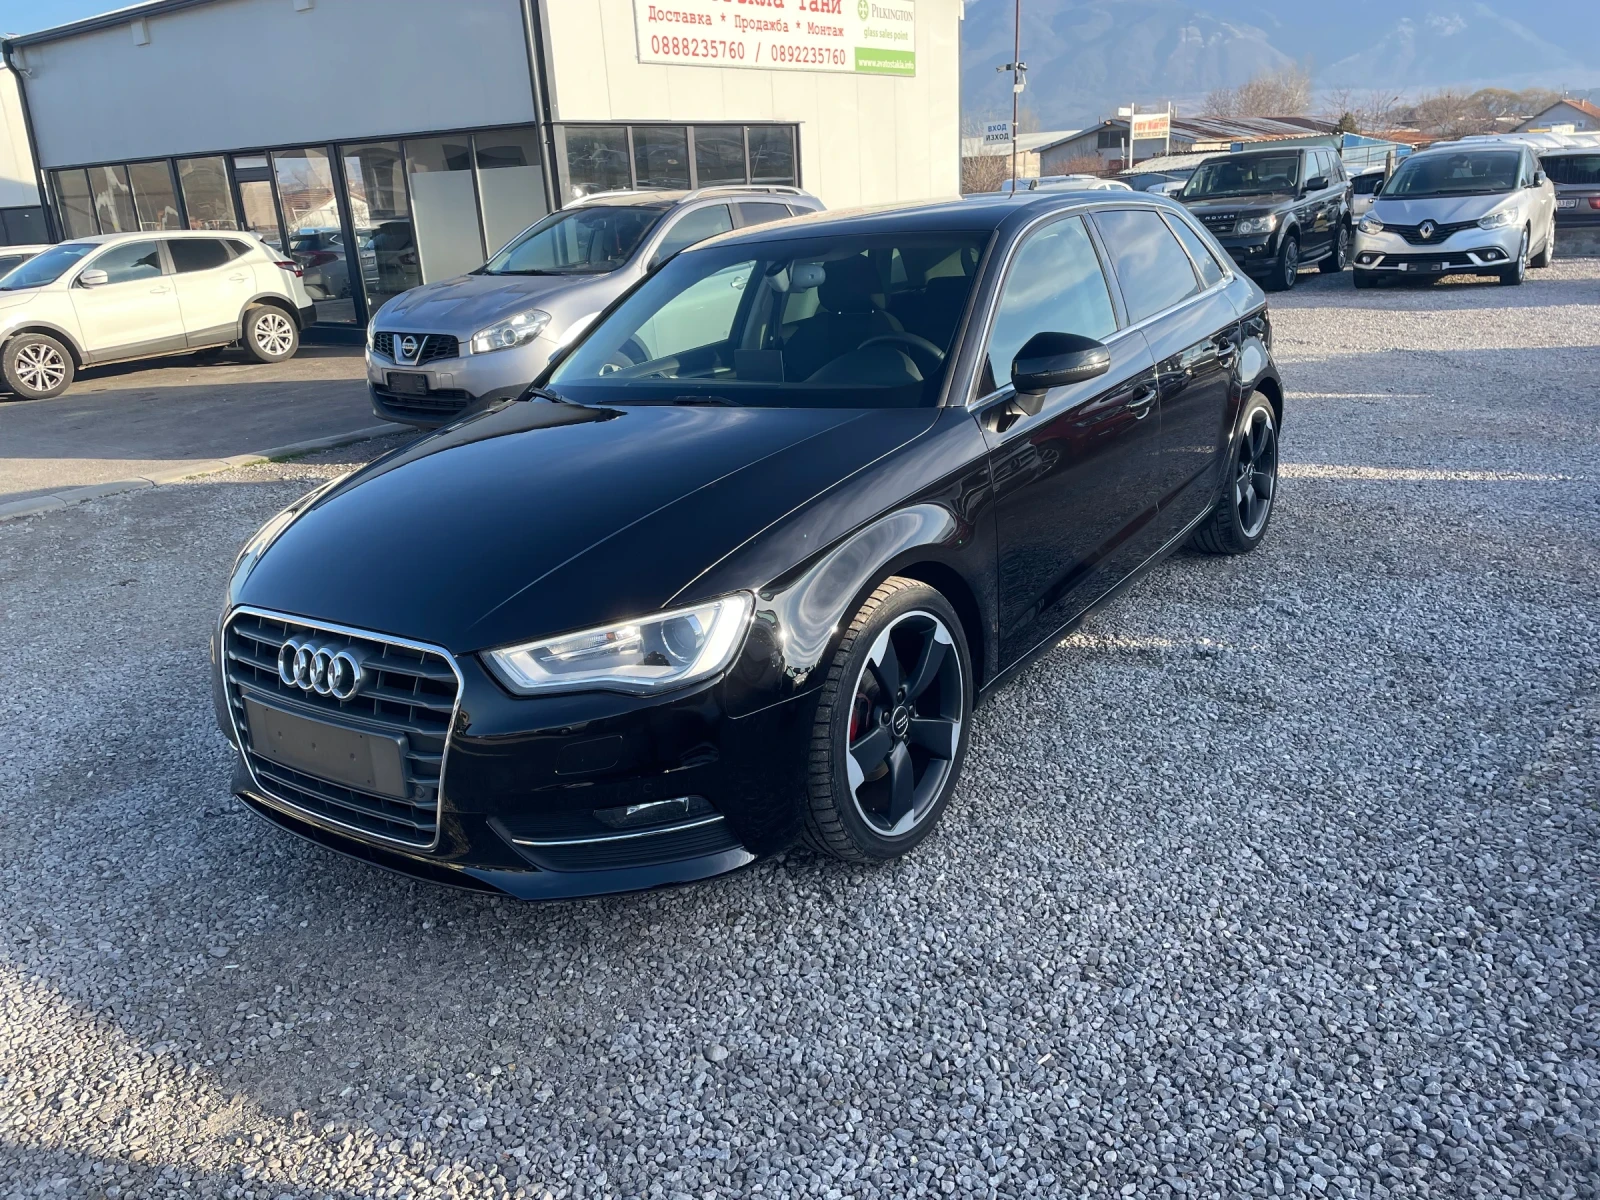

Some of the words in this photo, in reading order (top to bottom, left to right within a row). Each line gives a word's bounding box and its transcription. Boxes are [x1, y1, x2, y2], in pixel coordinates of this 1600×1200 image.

[648, 5, 712, 26] Доставка
[734, 14, 789, 33] Продажба
[807, 22, 844, 37] Монтаж
[871, 4, 914, 22] PILKINGTON
[864, 27, 878, 39] glass
[879, 28, 893, 39] sales
[894, 31, 908, 41] point
[651, 35, 745, 59] 0888235760
[771, 44, 846, 65] 0892235760
[988, 124, 1007, 132] ВХОД
[986, 133, 1009, 141] ИЗХОД
